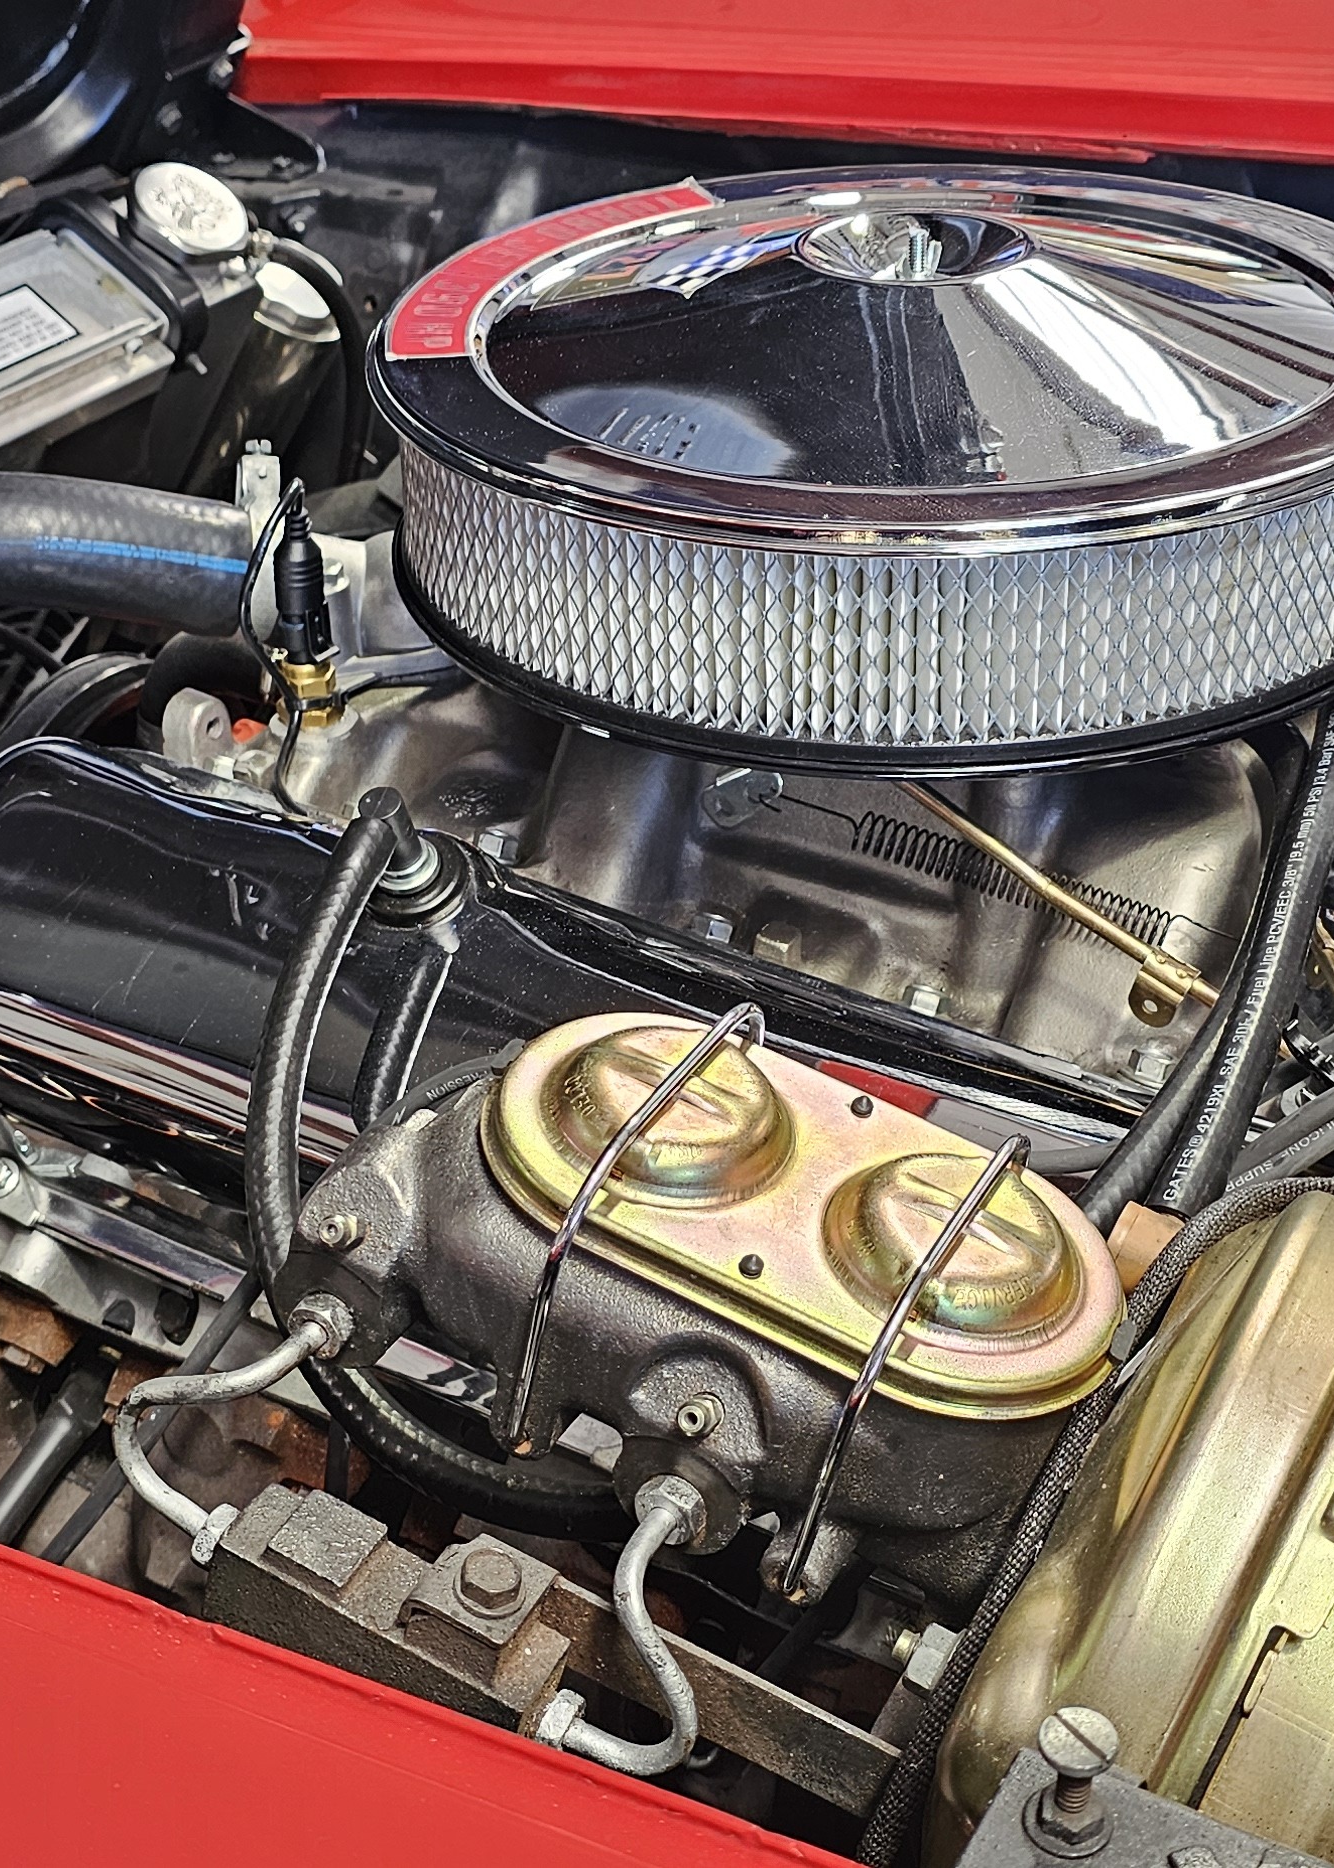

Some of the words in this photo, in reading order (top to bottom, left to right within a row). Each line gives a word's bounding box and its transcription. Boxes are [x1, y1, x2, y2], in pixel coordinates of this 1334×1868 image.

[1196, 1080, 1229, 1135] 4219XL
[1219, 1047, 1241, 1077] SAE
[1247, 976, 1270, 1009] Fuel
[1266, 889, 1293, 946] PCV/EEC
[1282, 863, 1299, 889] 3/8"
[1307, 785, 1324, 803] PSI
[953, 1275, 1036, 1311] SERVICE
